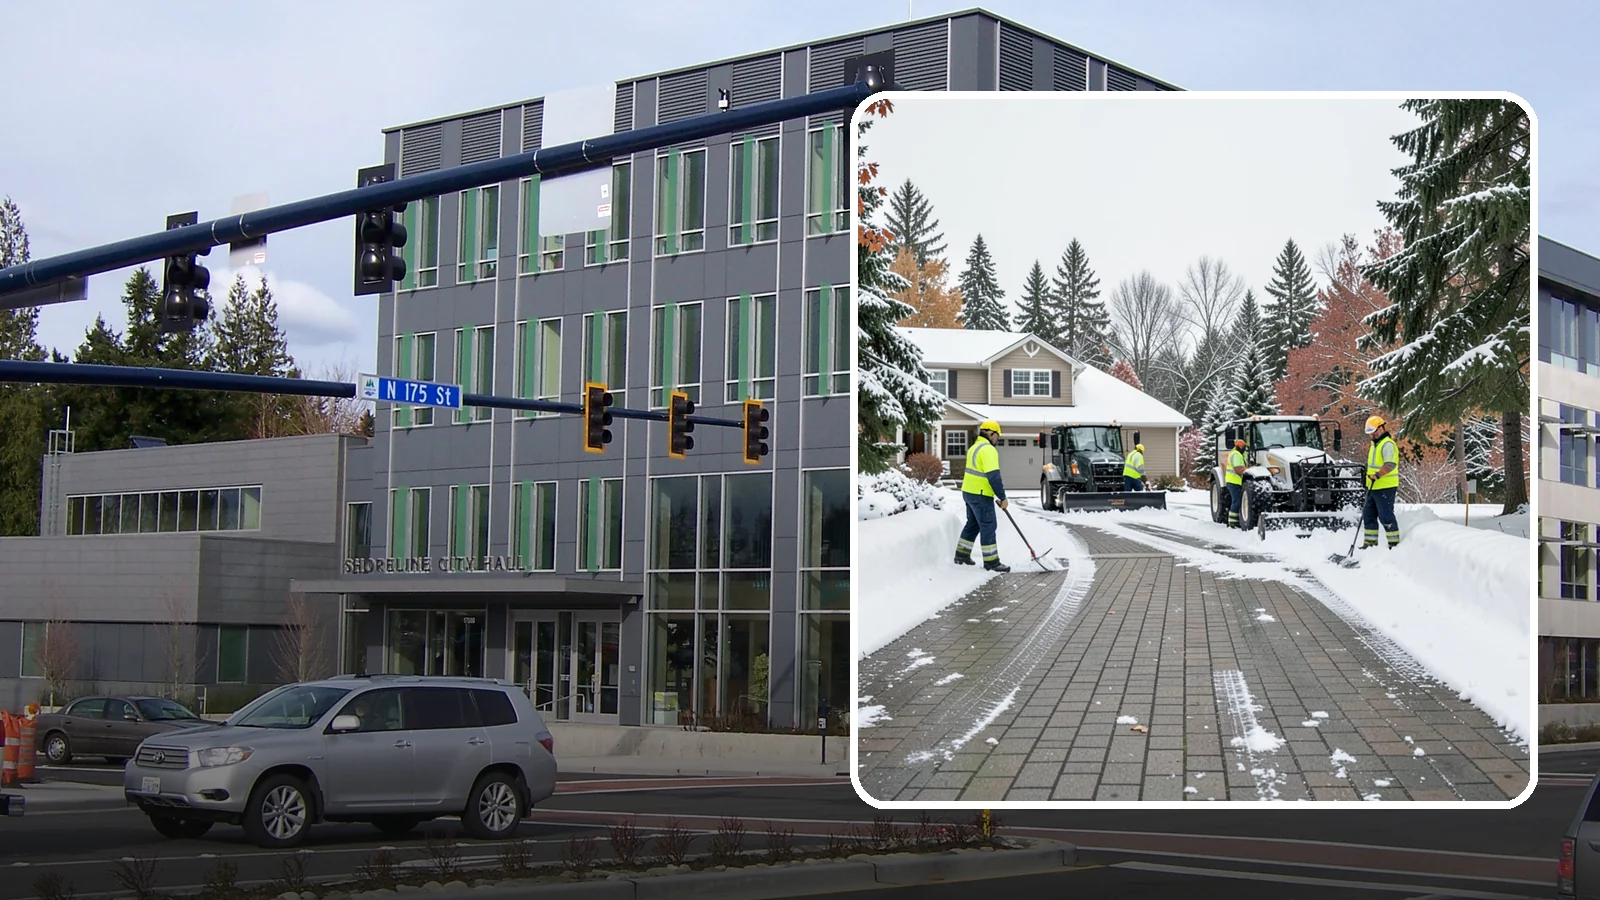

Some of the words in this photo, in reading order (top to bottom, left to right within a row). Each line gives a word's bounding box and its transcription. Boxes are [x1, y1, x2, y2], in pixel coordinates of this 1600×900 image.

[387, 381, 396, 399] N
[405, 382, 427, 403] 175
[436, 386, 451, 406] St
[344, 557, 431, 573] SHORELINE
[438, 556, 475, 572] CITY
[484, 555, 525, 571] HALL
